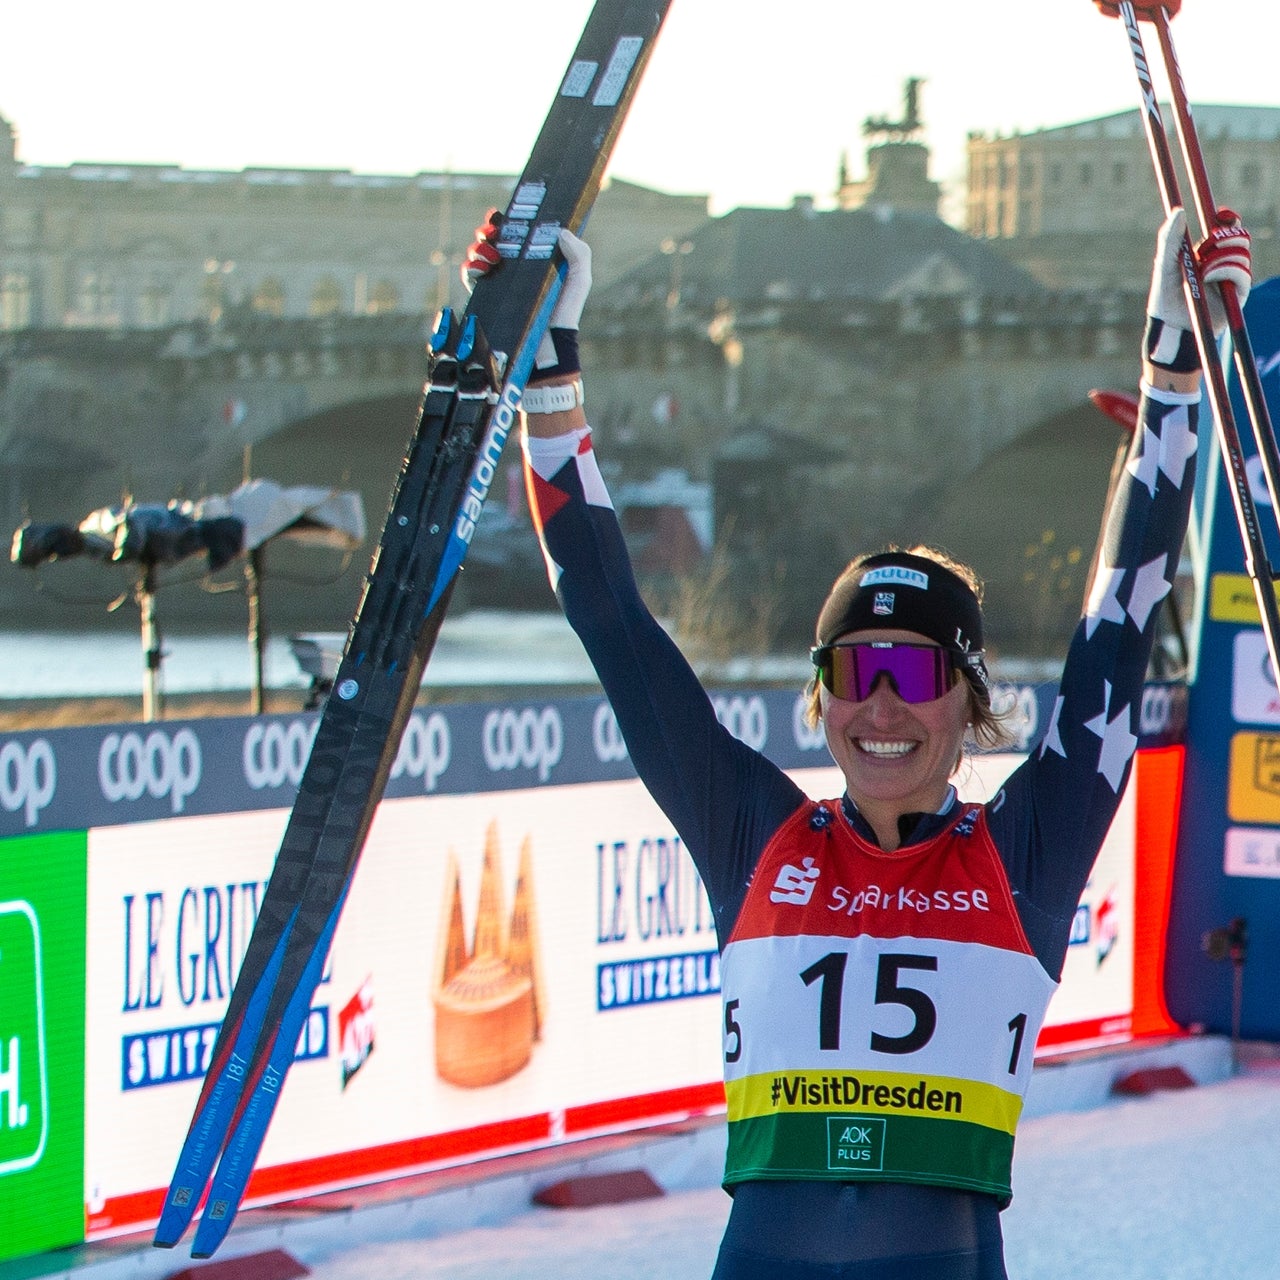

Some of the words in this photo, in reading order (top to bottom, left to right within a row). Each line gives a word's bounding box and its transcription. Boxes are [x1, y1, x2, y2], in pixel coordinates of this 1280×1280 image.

[483, 706, 563, 782] coop
[100, 728, 200, 813] coop
[597, 842, 627, 944] LE
[827, 884, 990, 916] Sparkasse
[122, 892, 163, 1013] LE
[799, 952, 939, 1056] 15
[226, 1051, 248, 1083] 187
[261, 1064, 282, 1094] 187
[771, 1076, 963, 1114] #VisitDresden
[837, 1147, 871, 1161] PLUS
[839, 1125, 872, 1145] AOK
